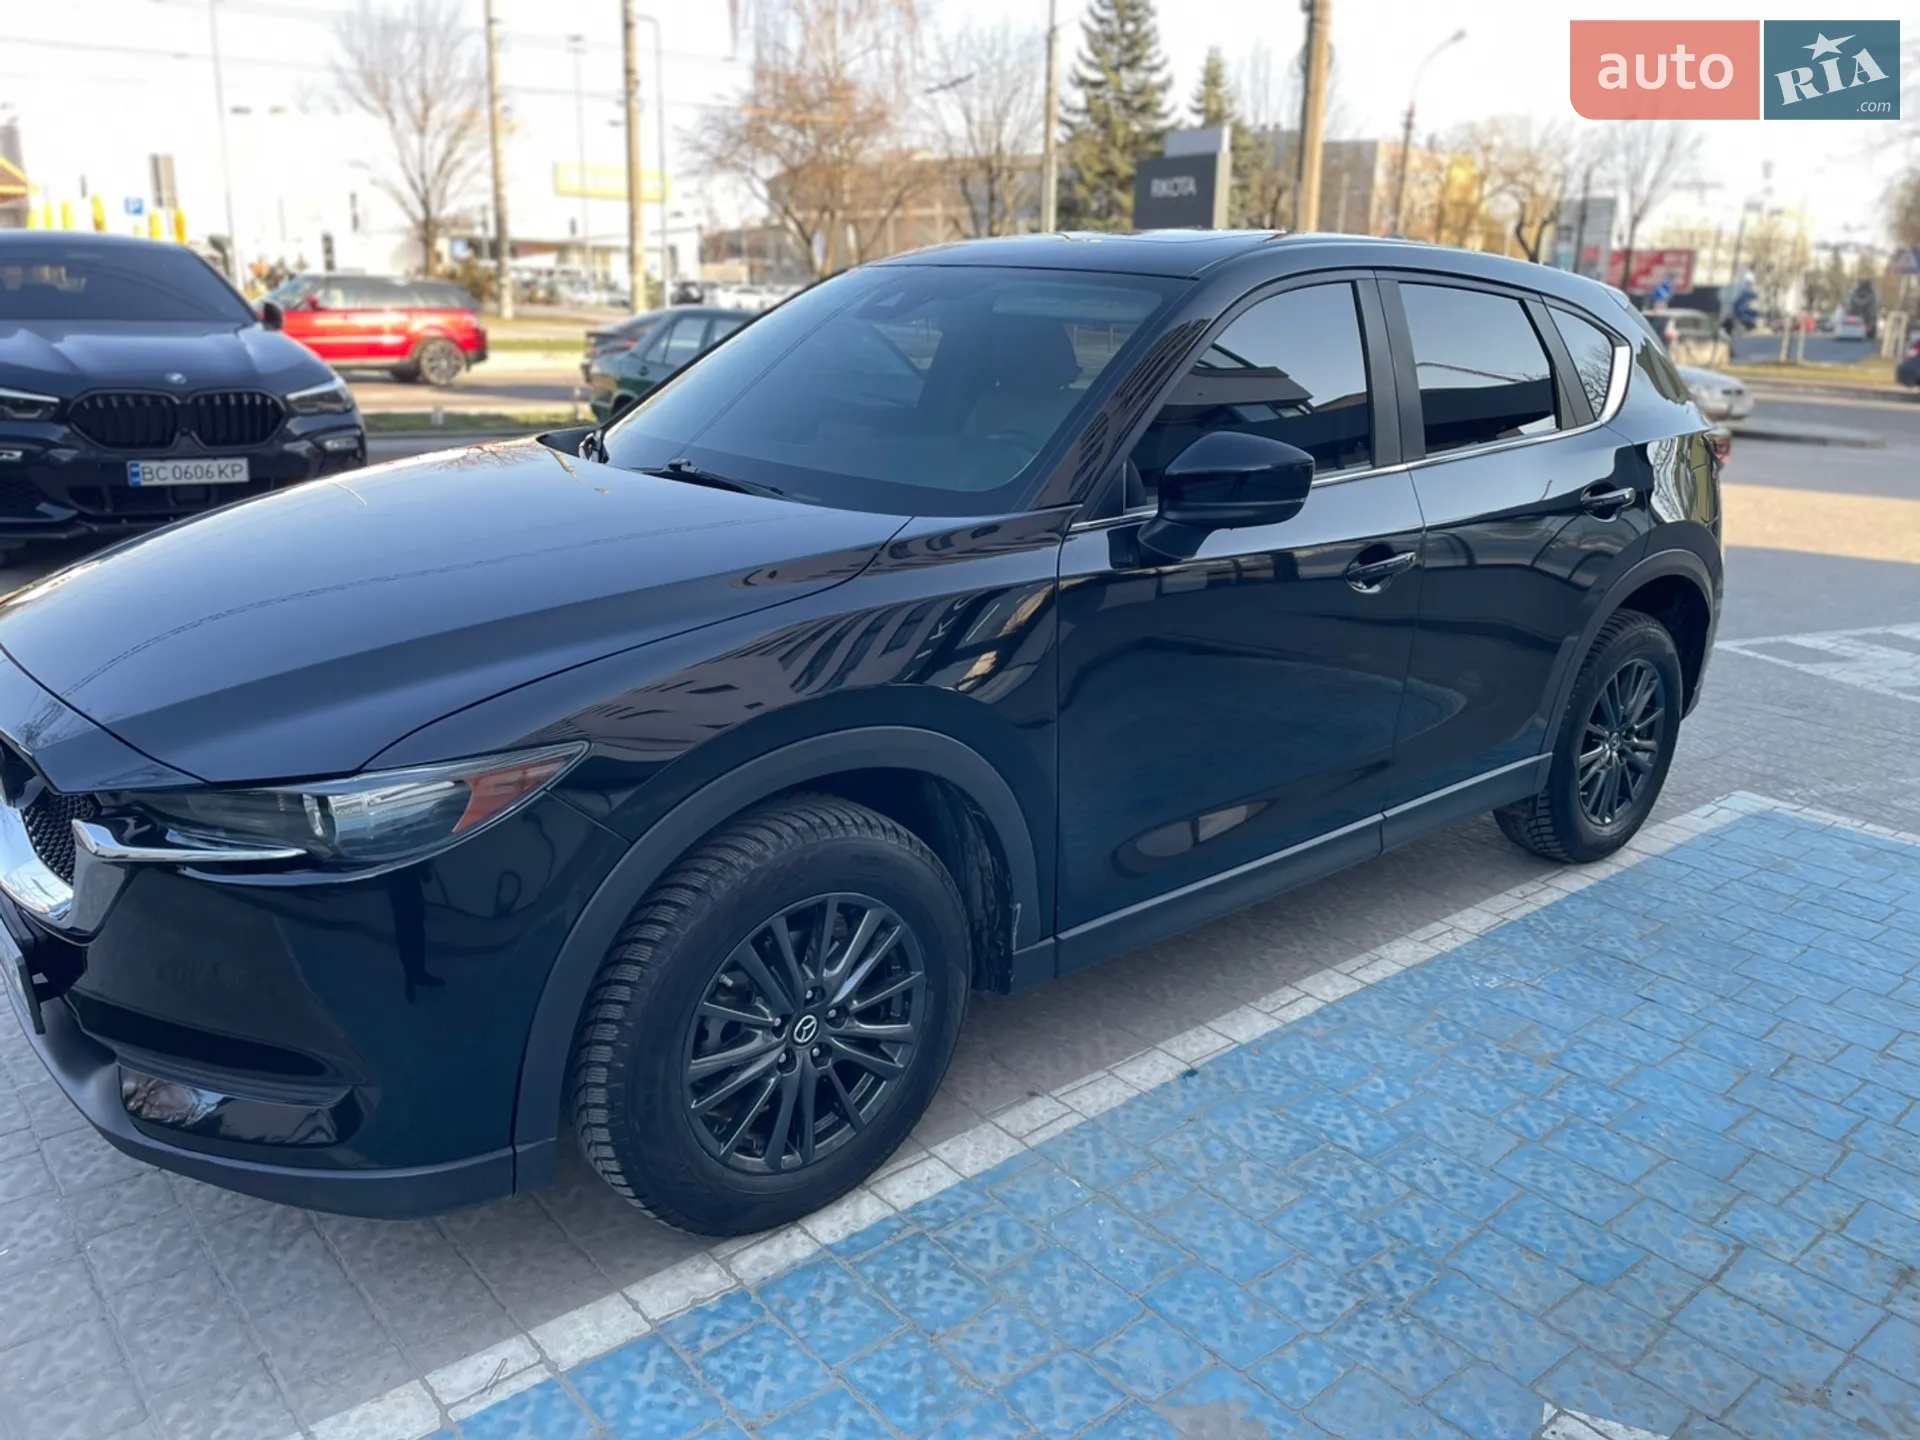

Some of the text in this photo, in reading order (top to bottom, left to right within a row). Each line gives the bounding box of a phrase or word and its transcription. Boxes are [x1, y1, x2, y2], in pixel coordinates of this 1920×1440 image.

[141, 463, 244, 482] BC 0606 KP
